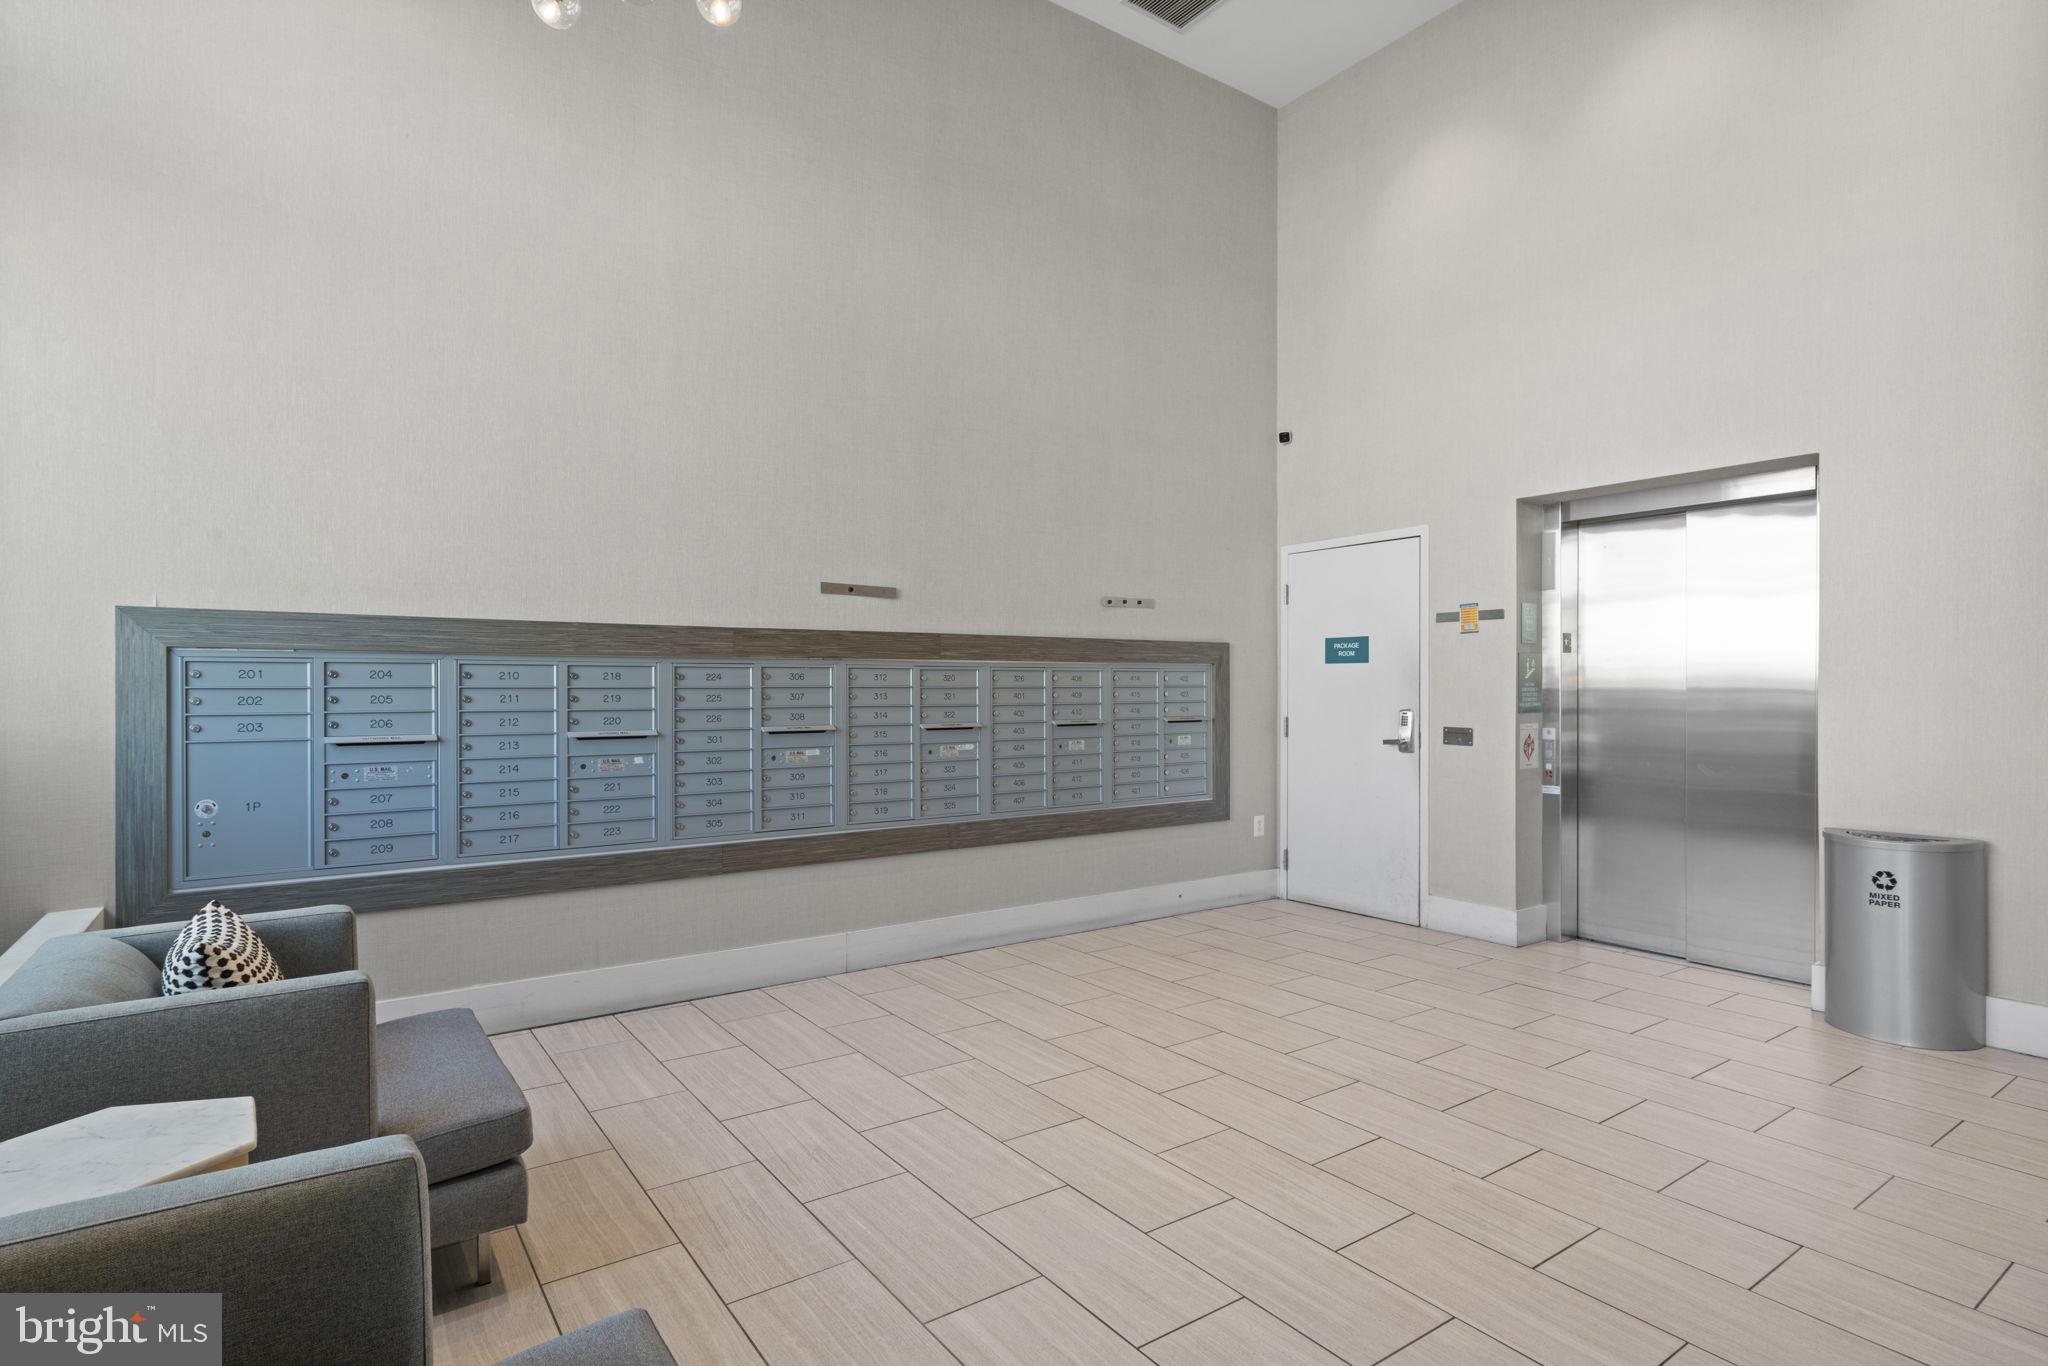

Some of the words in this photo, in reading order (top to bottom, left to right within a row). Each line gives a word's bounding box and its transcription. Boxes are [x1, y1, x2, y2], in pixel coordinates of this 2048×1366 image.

[238, 669, 264, 680] 201
[369, 669, 393, 680] 204
[498, 671, 520, 681] 210
[602, 671, 622, 681] 218
[705, 672, 722, 681] 224
[788, 672, 805, 681] 306
[873, 673, 888, 681] 312
[943, 674, 956, 682] 320
[370, 694, 393, 705] 205
[499, 694, 520, 704] 211
[602, 694, 622, 703] 219
[705, 694, 723, 703] 225
[789, 692, 805, 701] 307
[873, 692, 888, 700] 313
[943, 692, 956, 700] 321
[237, 696, 264, 707] 202
[705, 714, 723, 723] 226
[789, 712, 806, 721] 308
[873, 711, 888, 719] 314
[943, 711, 956, 719] 322
[370, 719, 393, 730] 206
[499, 717, 519, 727] 212
[602, 716, 622, 726] 220
[237, 722, 264, 733] 203
[873, 730, 888, 738] 315
[706, 736, 723, 744] 301
[498, 741, 520, 750] 213
[1012, 744, 1025, 752] 404
[873, 749, 888, 758] 316
[705, 756, 722, 765] 302
[499, 764, 519, 774] 214
[873, 768, 888, 777] 317
[943, 765, 956, 773] 323
[789, 772, 806, 781] 309
[705, 777, 723, 786] 303
[603, 782, 621, 792] 221
[873, 787, 888, 796] 318
[943, 783, 956, 792] 324
[499, 787, 520, 798] 215
[789, 792, 806, 801] 310
[370, 793, 393, 804] 207
[705, 798, 723, 808] 304
[1013, 797, 1025, 805] 407
[245, 802, 262, 812] 1P
[602, 805, 621, 814] 222
[874, 806, 889, 815] 319
[943, 802, 956, 810] 325
[499, 811, 520, 821] 216
[790, 812, 805, 821] 311
[370, 819, 393, 830] 208
[705, 819, 724, 829] 305
[603, 827, 622, 837] 223
[499, 834, 520, 845] 217
[370, 844, 394, 855] 209
[1869, 892, 1900, 902] MIXED
[1868, 899, 1901, 909] PAPER
